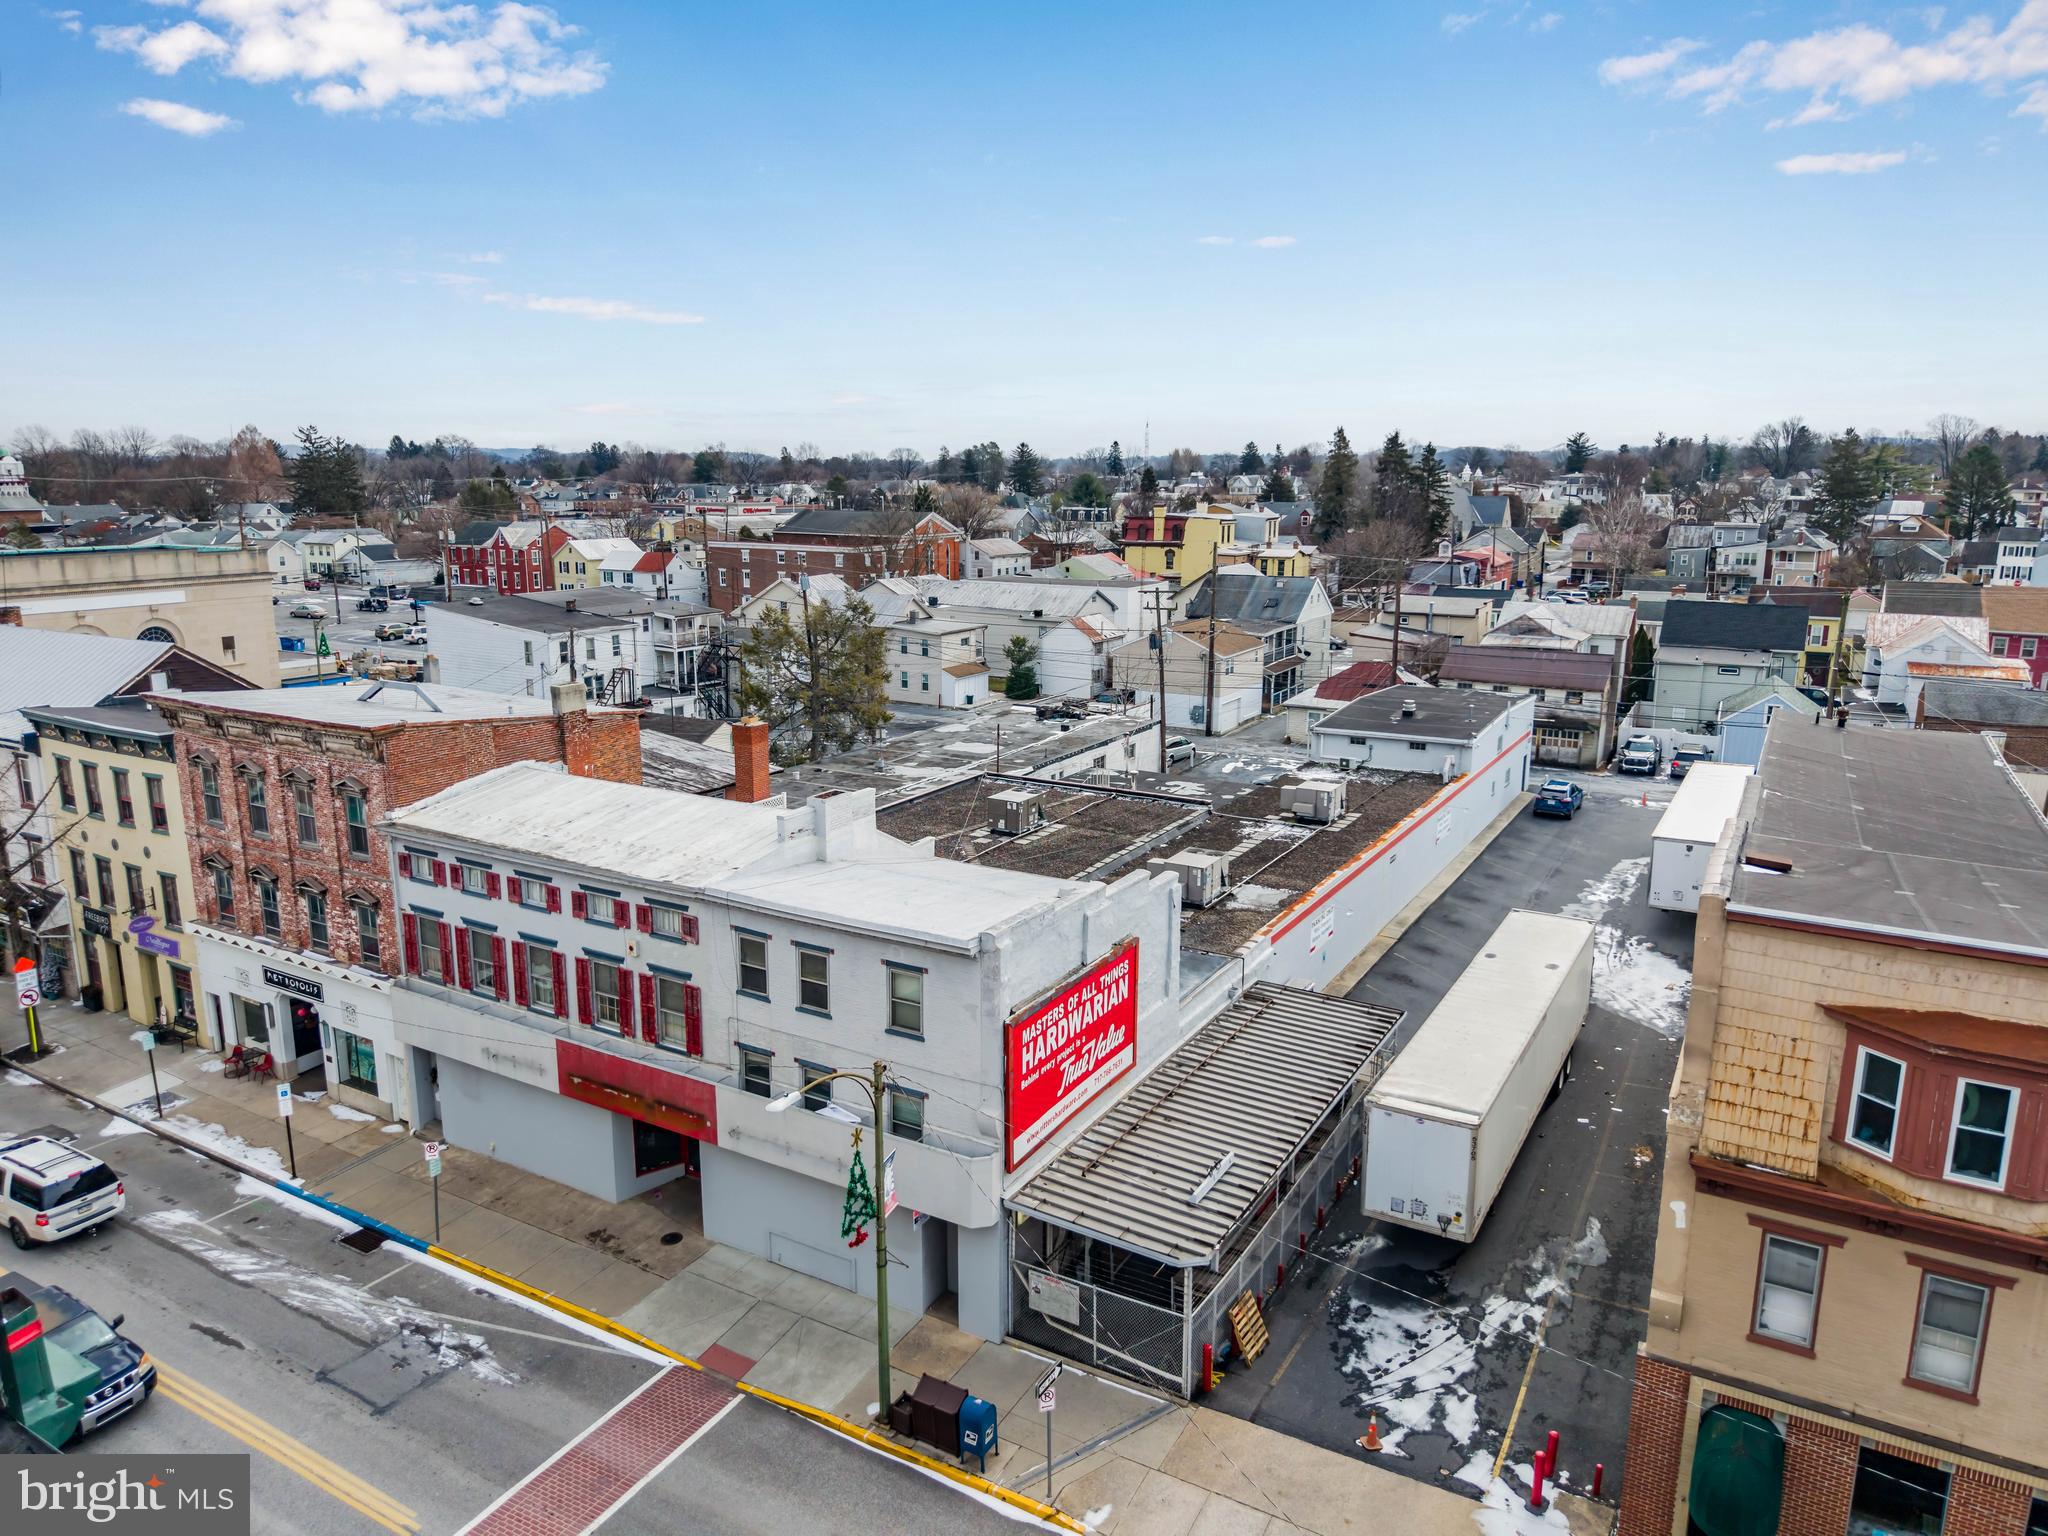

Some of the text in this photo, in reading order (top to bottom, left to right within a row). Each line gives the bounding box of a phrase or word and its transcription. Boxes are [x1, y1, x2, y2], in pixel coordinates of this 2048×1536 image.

[1022, 959, 1129, 1045] MASTERS OF ALL THINGS
[1022, 974, 1129, 1075] HARDWARIAN
[1021, 1070, 1040, 1091] Behind
[1040, 1058, 1056, 1075] every
[1057, 1043, 1075, 1065] project
[1075, 1039, 1081, 1048] is
